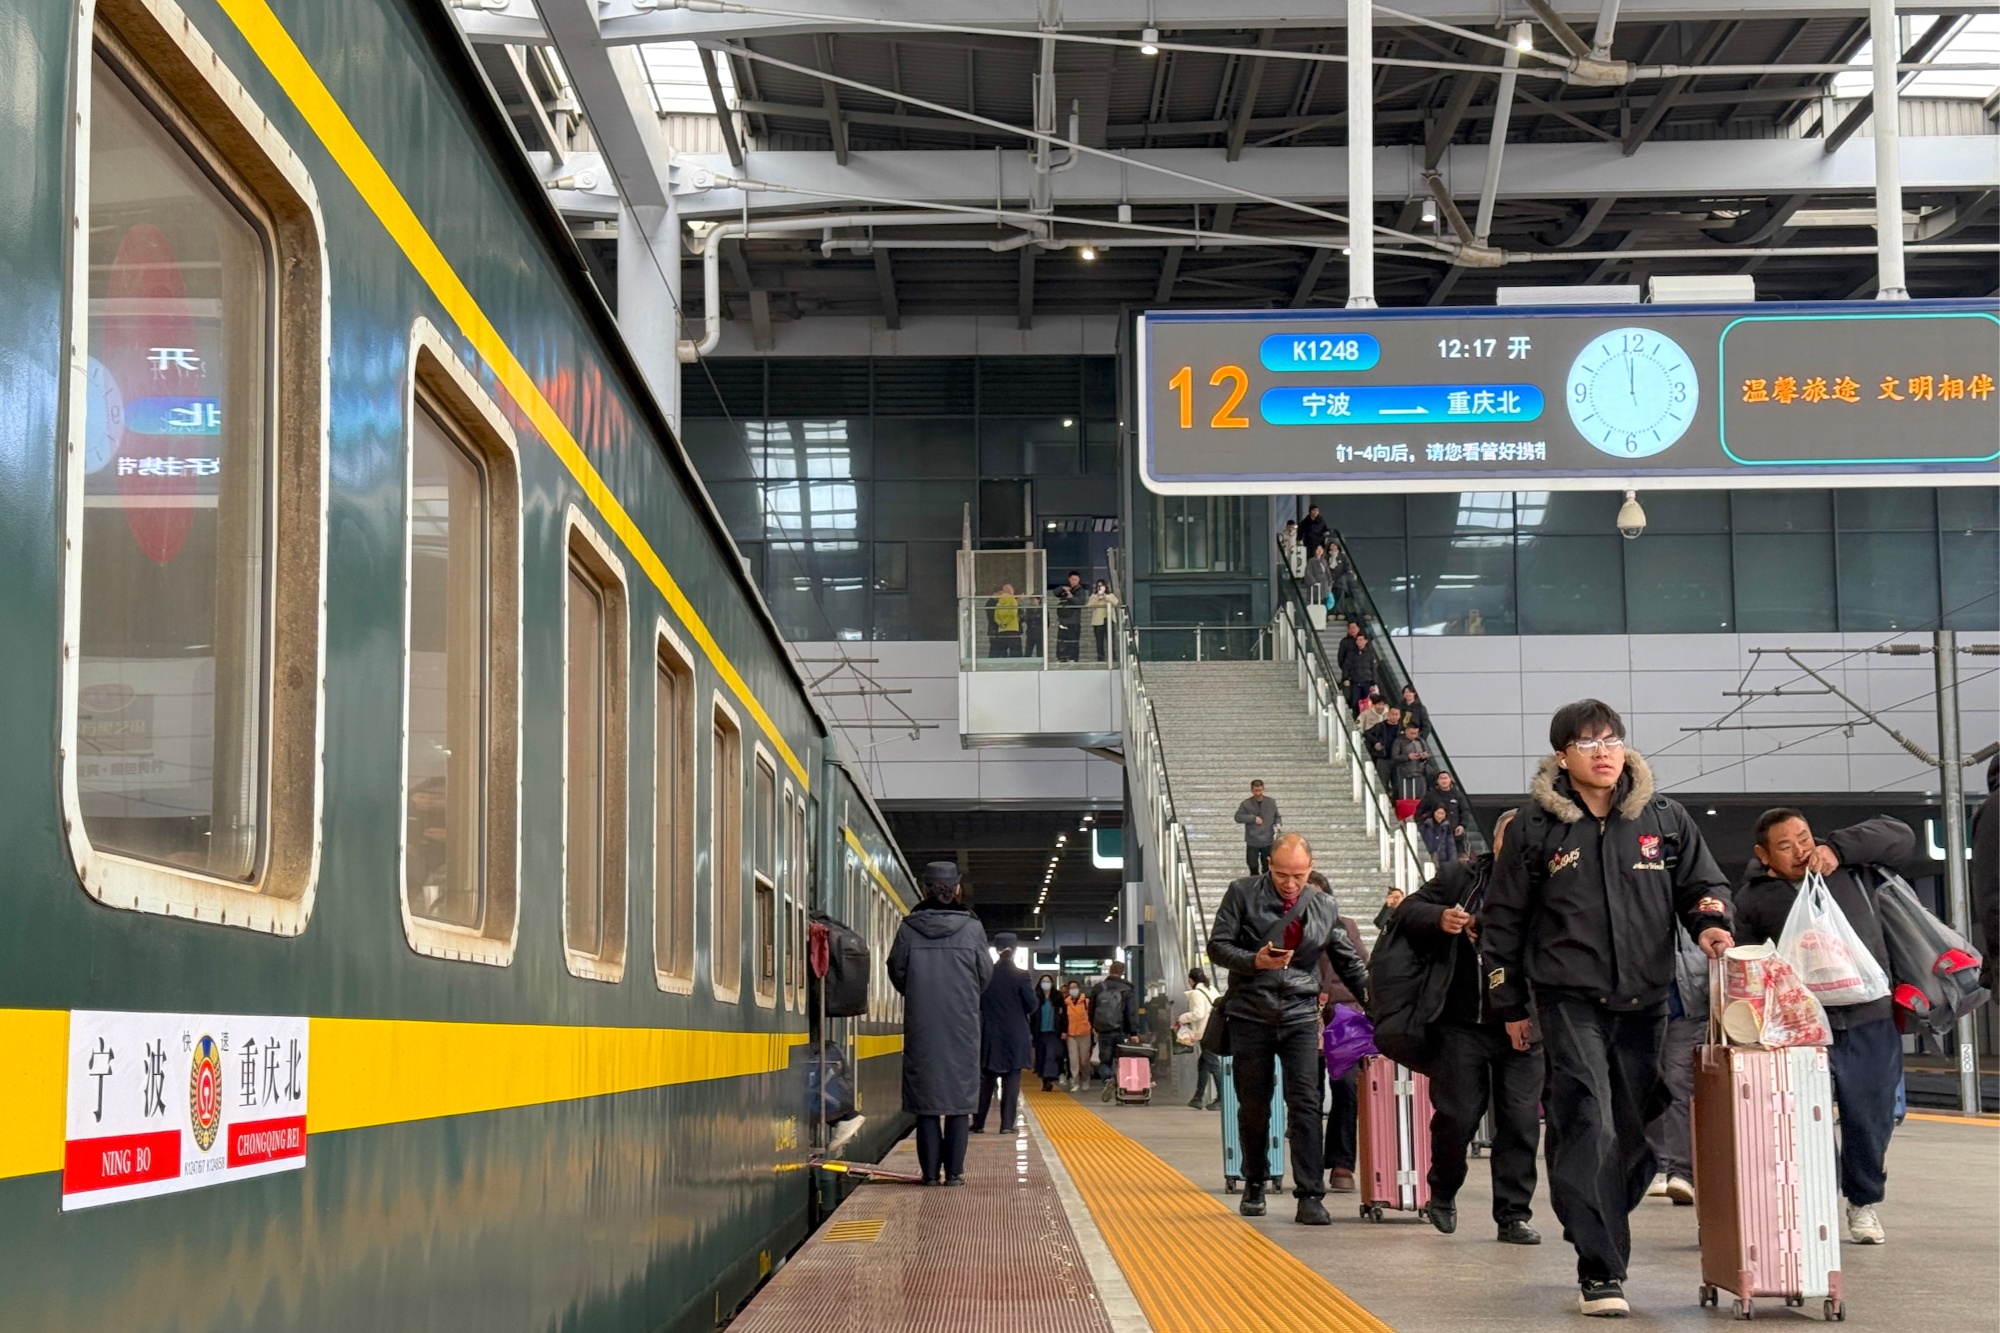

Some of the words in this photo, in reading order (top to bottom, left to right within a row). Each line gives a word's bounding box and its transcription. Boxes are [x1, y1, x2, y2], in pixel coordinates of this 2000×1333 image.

[1293, 340, 1359, 362] K1248
[1438, 338, 1497, 358] 12:17
[1507, 336, 1531, 360] 开
[1621, 333, 1644, 353] 12
[1169, 365, 1249, 429] 12
[1574, 382, 1587, 404] 9
[1674, 381, 1686, 403] 3
[1743, 375, 1861, 404] 温馨旅途
[1877, 373, 1996, 402] 文明相伴
[1302, 391, 1351, 418] 宁波
[1446, 390, 1521, 415] 重庆北
[1625, 433, 1638, 453] 6
[182, 1030, 192, 1053] 快
[88, 1036, 168, 1124] 宁波
[238, 1036, 302, 1107] 重庆北
[237, 1129, 286, 1158] CHONGQING
[286, 1127, 300, 1149] BEI
[101, 1149, 131, 1177] NING
[136, 1146, 151, 1172] BO
